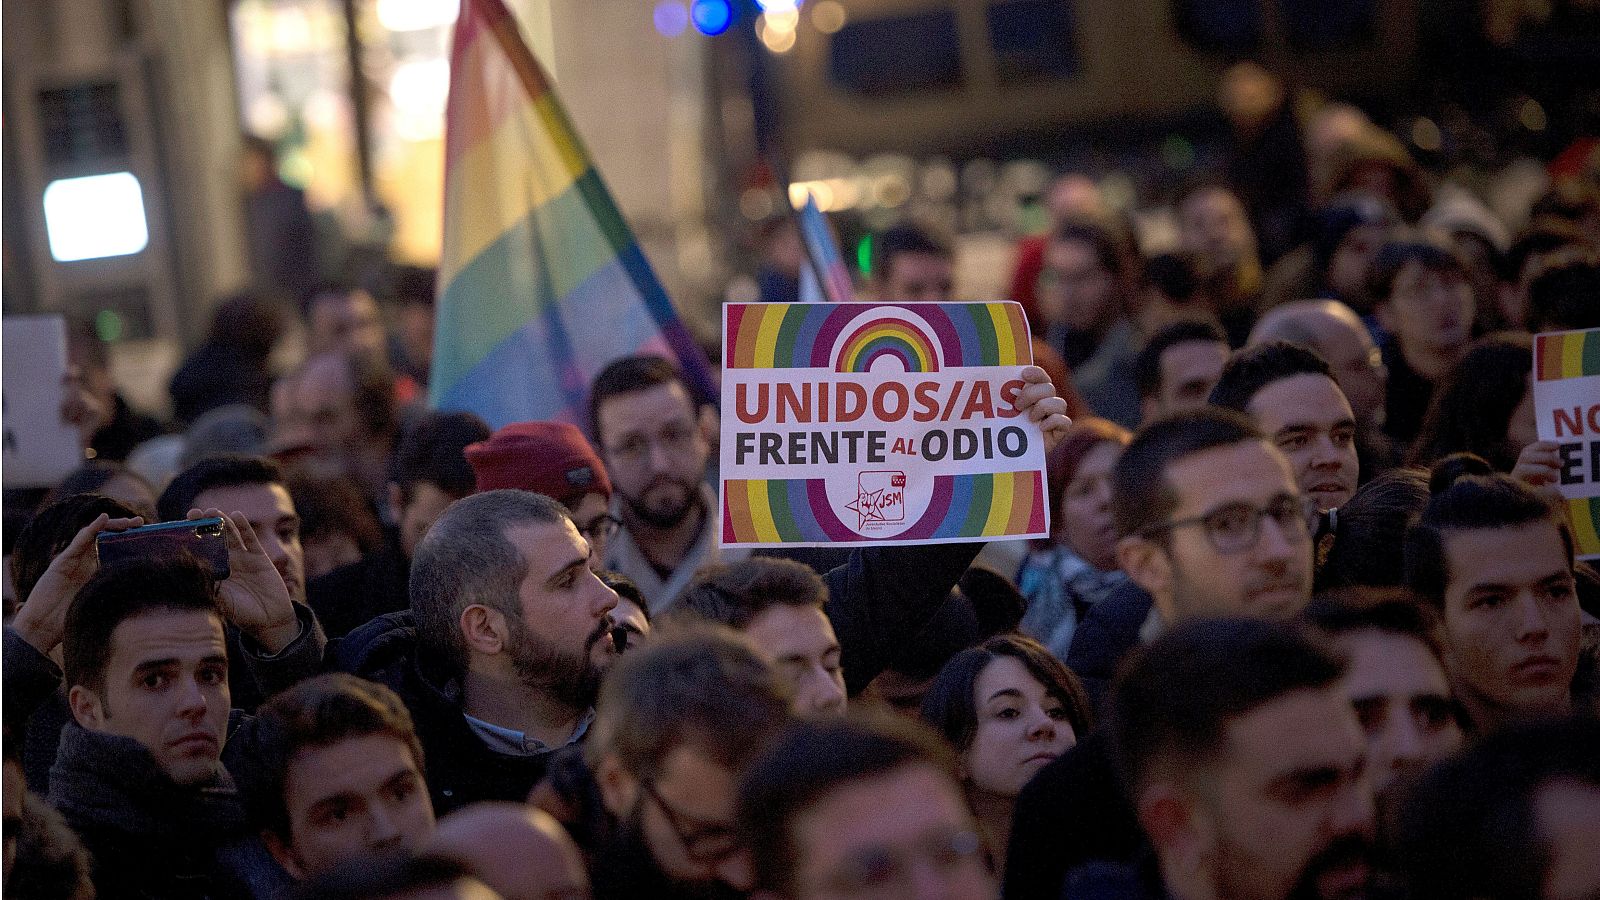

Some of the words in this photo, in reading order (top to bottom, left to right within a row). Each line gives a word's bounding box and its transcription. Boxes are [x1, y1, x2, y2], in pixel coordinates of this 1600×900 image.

[735, 380, 1026, 424] UNIDOS/AS
[735, 430, 887, 465] FRENTE
[891, 437, 918, 455] AL
[921, 426, 1029, 462] ODIO
[879, 492, 902, 509] JSM
